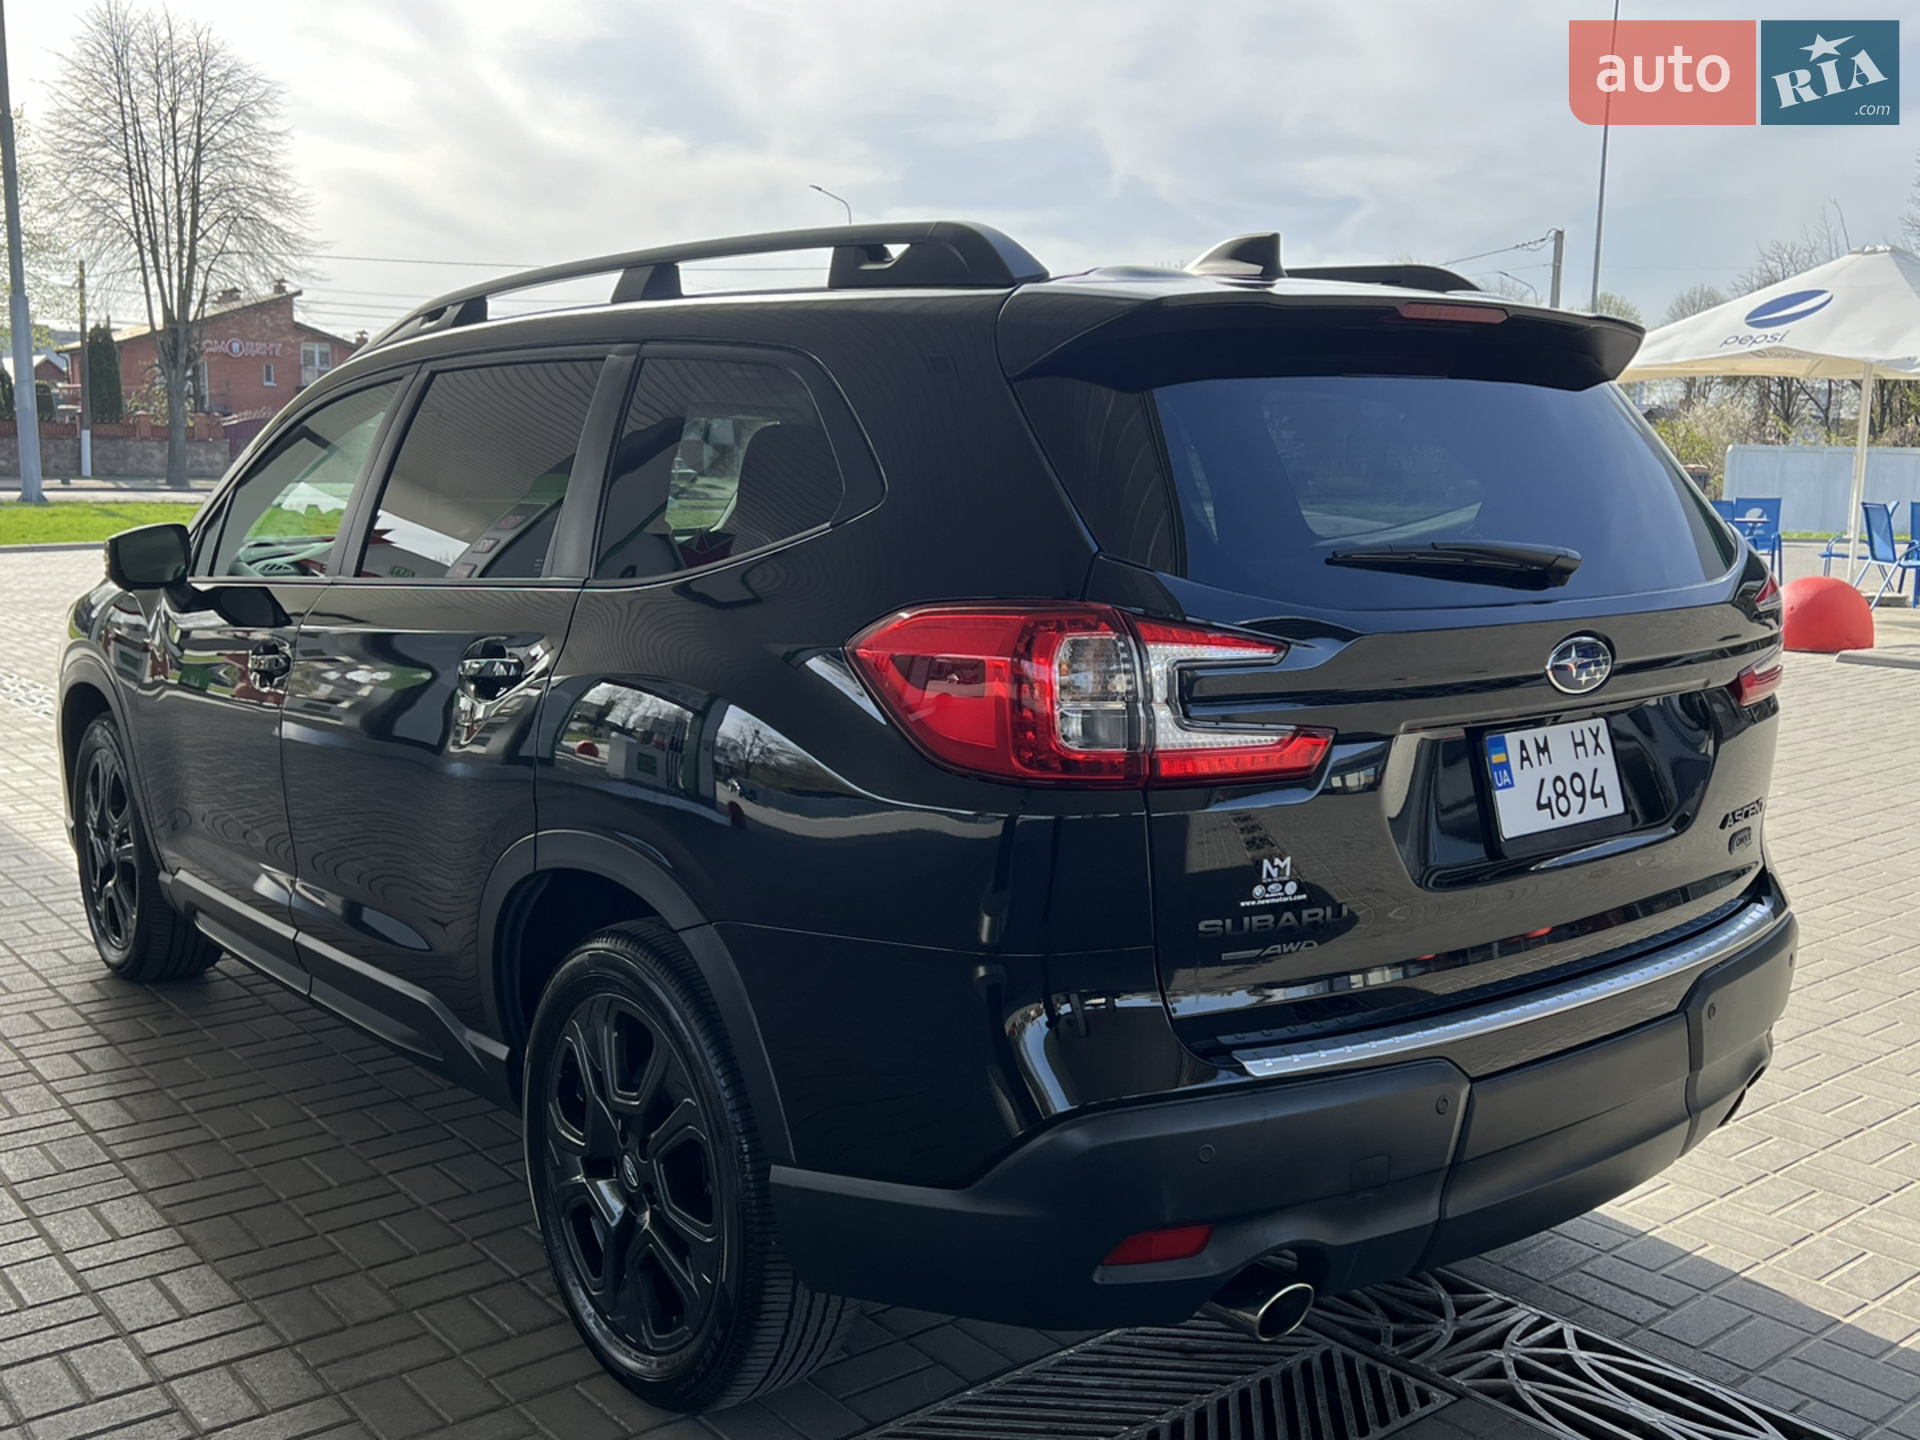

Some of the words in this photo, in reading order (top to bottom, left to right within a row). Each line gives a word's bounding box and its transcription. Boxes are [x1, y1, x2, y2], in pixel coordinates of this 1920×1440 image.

[1719, 330, 1790, 348] pepsi
[1519, 735, 1552, 771] AM
[1570, 725, 1606, 760] HX
[1494, 769, 1512, 787] UA
[1535, 767, 1609, 821] 4894
[1198, 903, 1349, 937] SUBARU
[1260, 939, 1319, 956] AWD
